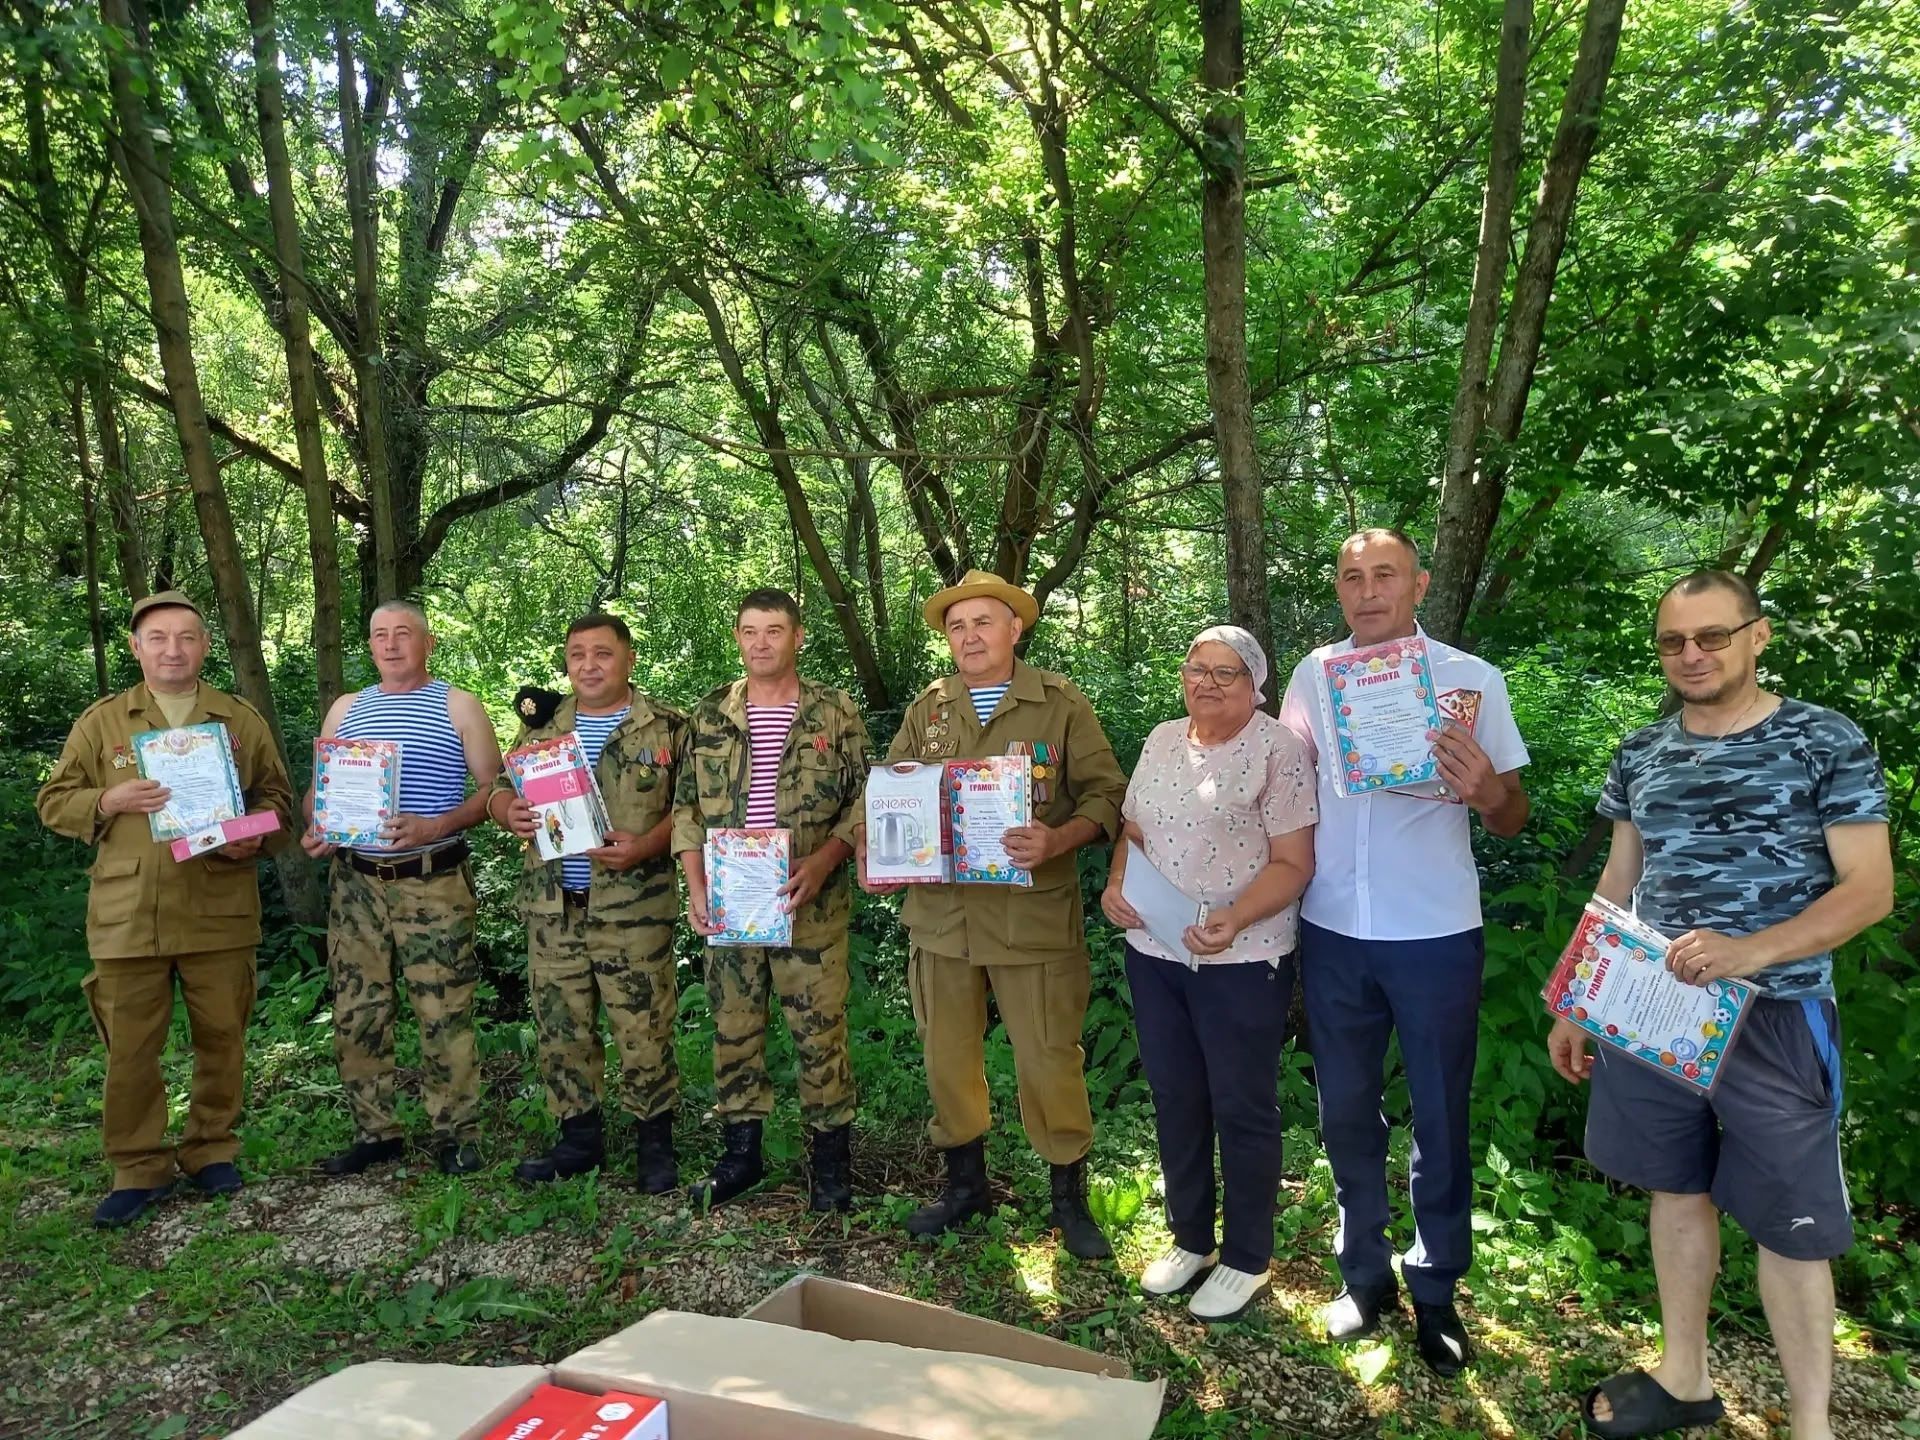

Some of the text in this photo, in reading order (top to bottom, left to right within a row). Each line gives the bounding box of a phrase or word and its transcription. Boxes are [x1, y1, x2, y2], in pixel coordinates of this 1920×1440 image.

[1356, 670, 1400, 687] ГРАМОТА
[338, 758, 372, 767] ГРАМОТА
[532, 759, 561, 773] ГРАМОТА
[969, 783, 1001, 792] ГРАМОТА
[1586, 957, 1612, 1001] ГРАМОТА
